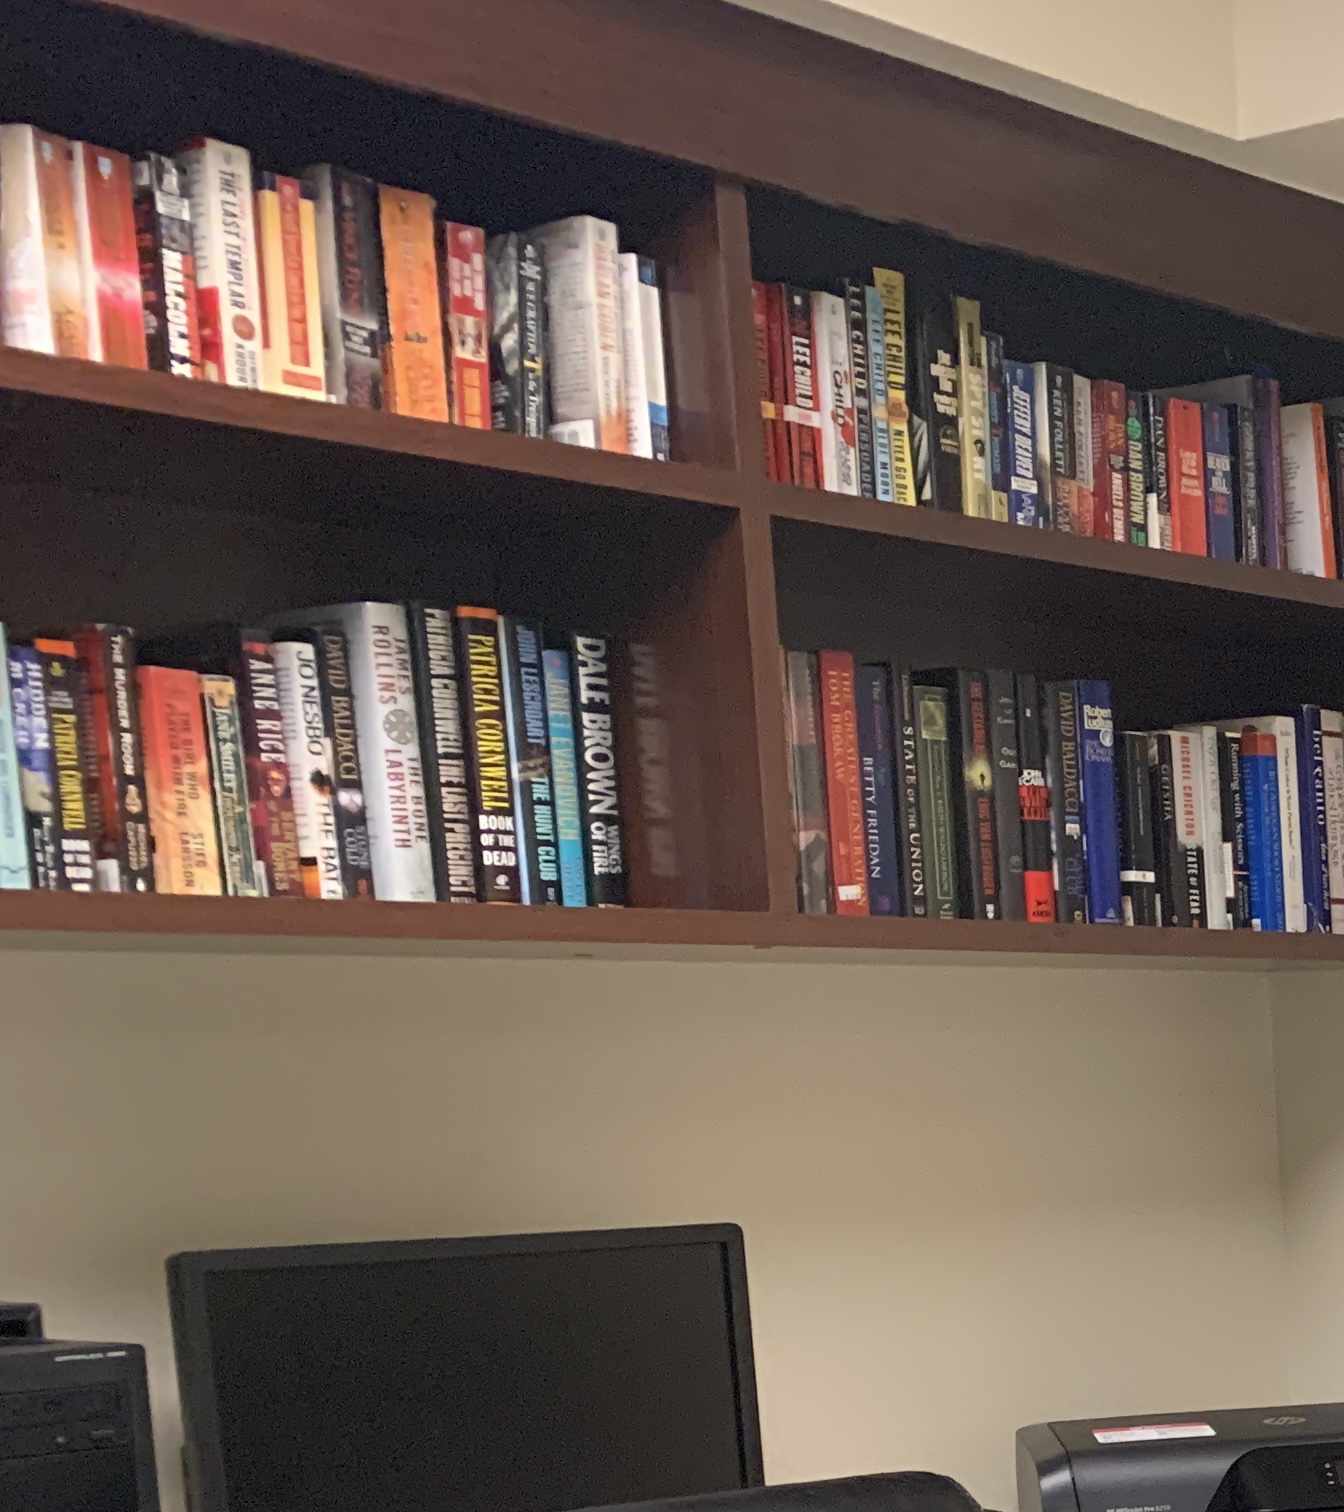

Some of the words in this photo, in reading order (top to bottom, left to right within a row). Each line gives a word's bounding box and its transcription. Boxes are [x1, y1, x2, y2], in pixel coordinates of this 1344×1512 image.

[218, 171, 237, 198] THE
[220, 200, 241, 237] LAST
[224, 243, 247, 310] TEMPLAR
[162, 248, 190, 357] MALCOLM
[849, 285, 864, 319] LEE
[883, 308, 904, 336] LEE
[171, 361, 194, 380] X
[234, 343, 248, 385] KHOUR
[791, 335, 810, 362] LEE
[852, 329, 868, 390] CHILD
[886, 343, 906, 392] CHILD
[793, 366, 813, 409] CHILD
[873, 351, 885, 397] CHILD
[968, 372, 984, 409] SPY
[831, 370, 845, 428] CHILD
[1012, 385, 1032, 436] JEFFERY
[1051, 388, 1063, 417] KEN
[892, 429, 906, 463] NEVER
[1054, 420, 1066, 474] FOLLETT
[1127, 439, 1143, 471] DAN
[1154, 416, 1165, 449] DAN
[880, 461, 891, 496] MOON
[895, 466, 907, 480] GO
[1014, 433, 1034, 479] DEAVER
[1156, 451, 1169, 500] BROWN
[896, 483, 908, 504] BAC
[1111, 471, 1124, 508] ANGELS
[1129, 471, 1145, 525] BROWN
[1112, 508, 1126, 543] DEMON
[111, 635, 125, 663] THE
[296, 650, 316, 679] JO
[323, 634, 348, 690] DAVID
[372, 624, 399, 705] ROLLINS
[424, 608, 457, 677] PATRICIA
[515, 625, 538, 664] JOHN
[249, 659, 279, 710] ANNE
[393, 637, 413, 696] JAMES
[467, 634, 502, 712] PATRICIA
[574, 635, 612, 707] DALE
[828, 671, 841, 706] TOM
[841, 670, 854, 703] THE
[113, 667, 131, 729] MURDER
[430, 678, 464, 754] CORNWELL
[546, 672, 573, 729] JANET
[1059, 691, 1075, 737] DAVID
[51, 712, 79, 767] PATRICIA
[120, 733, 135, 777] ROOM
[256, 718, 286, 764] RICE
[331, 694, 359, 780] BALDACCI
[830, 711, 848, 785] BROKAW
[844, 709, 861, 793] GREATEST
[902, 726, 917, 786] STATE
[1180, 735, 1194, 781] MICHAEL
[187, 771, 200, 800] WHO
[220, 741, 237, 792] SMILEY
[407, 757, 422, 788] THE
[438, 758, 466, 784] THE
[474, 718, 510, 811] CORNWELL
[580, 711, 619, 816] BROWN
[864, 756, 877, 805] BETTY
[1062, 741, 1080, 813] BALDACCI
[1229, 742, 1241, 792] Running
[59, 769, 87, 832] CORNWELL
[175, 789, 188, 818] FIRE
[384, 748, 412, 849] LABYRINTH
[440, 786, 469, 820] LAST
[533, 776, 551, 803] THE
[550, 736, 580, 841] EVANOVICH
[1159, 763, 1172, 822] GEISHA
[1182, 785, 1196, 837] CRICHTON
[1233, 793, 1243, 819] with
[411, 795, 428, 844] BONE
[479, 814, 514, 831] BOOK
[536, 804, 555, 842] HUNT
[590, 821, 606, 842] OF
[908, 803, 917, 830] THE
[179, 832, 195, 888] LARSSON
[191, 832, 207, 868] STIEG
[343, 827, 359, 867] COLD
[443, 823, 475, 894] PRECINCT
[480, 833, 494, 846] OF
[497, 834, 515, 847] THE
[482, 850, 517, 866] DEAD
[593, 844, 609, 877] FIRE
[607, 824, 623, 875] WINGS
[849, 798, 868, 907] GENERATION
[866, 808, 882, 879] FRIEDAN
[1185, 843, 1199, 875] STATE
[1235, 821, 1246, 867] Scissors
[322, 846, 340, 883] BAT
[539, 846, 559, 881] CLUB
[909, 832, 925, 898] UNION
[1189, 888, 1202, 915] FEAR
